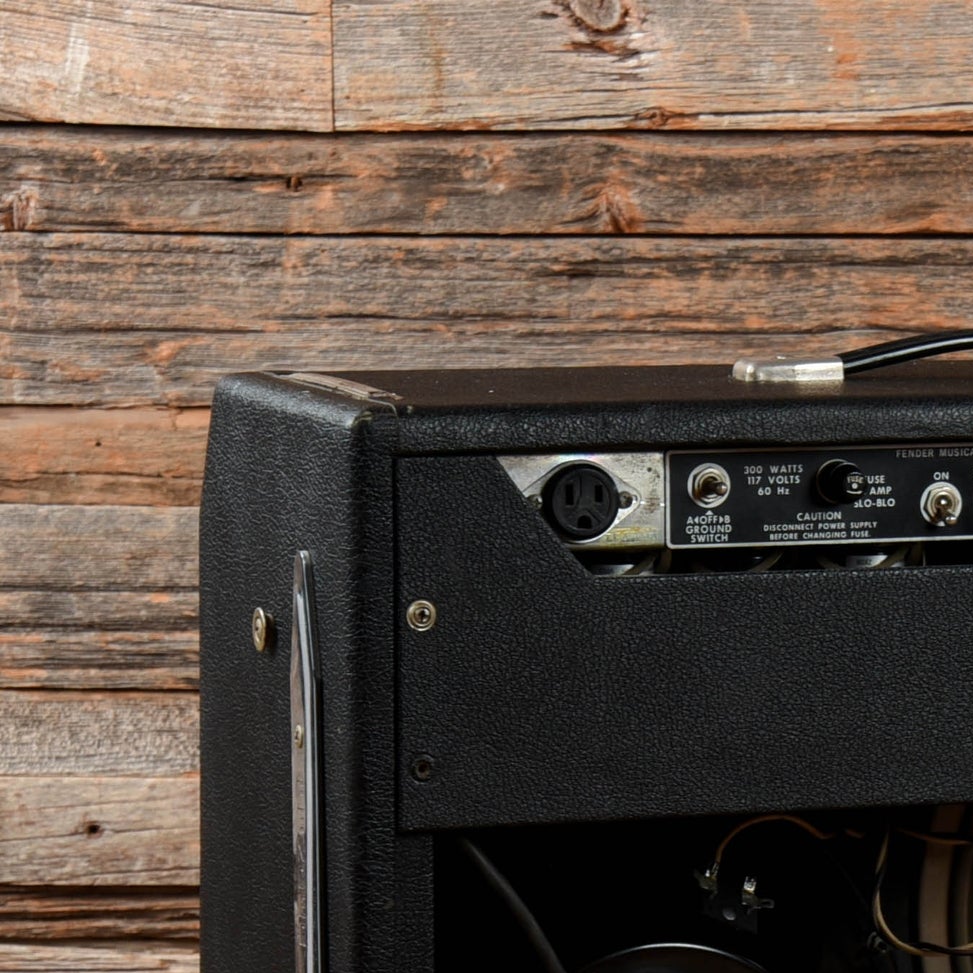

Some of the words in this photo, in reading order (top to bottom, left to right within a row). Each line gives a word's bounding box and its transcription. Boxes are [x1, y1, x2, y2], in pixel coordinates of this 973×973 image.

[896, 449, 934, 458] FENDER
[743, 465, 763, 474] 300
[769, 464, 804, 474] WATTS
[747, 476, 761, 485] 117
[768, 475, 800, 485] VOLTS
[864, 475, 886, 484] USE
[933, 472, 949, 481] ON
[757, 487, 771, 496] 60
[777, 486, 790, 495] Hz
[869, 486, 892, 495] AMP
[797, 512, 842, 521] CAUTION
[685, 525, 732, 534] GROUND
[763, 524, 813, 532] DISCONNECT
[818, 522, 845, 531] POWER
[850, 521, 877, 529] SUPPLY
[690, 534, 729, 543] SWITCH
[769, 533, 798, 541] BEFORE
[803, 531, 847, 540] CHANGING
